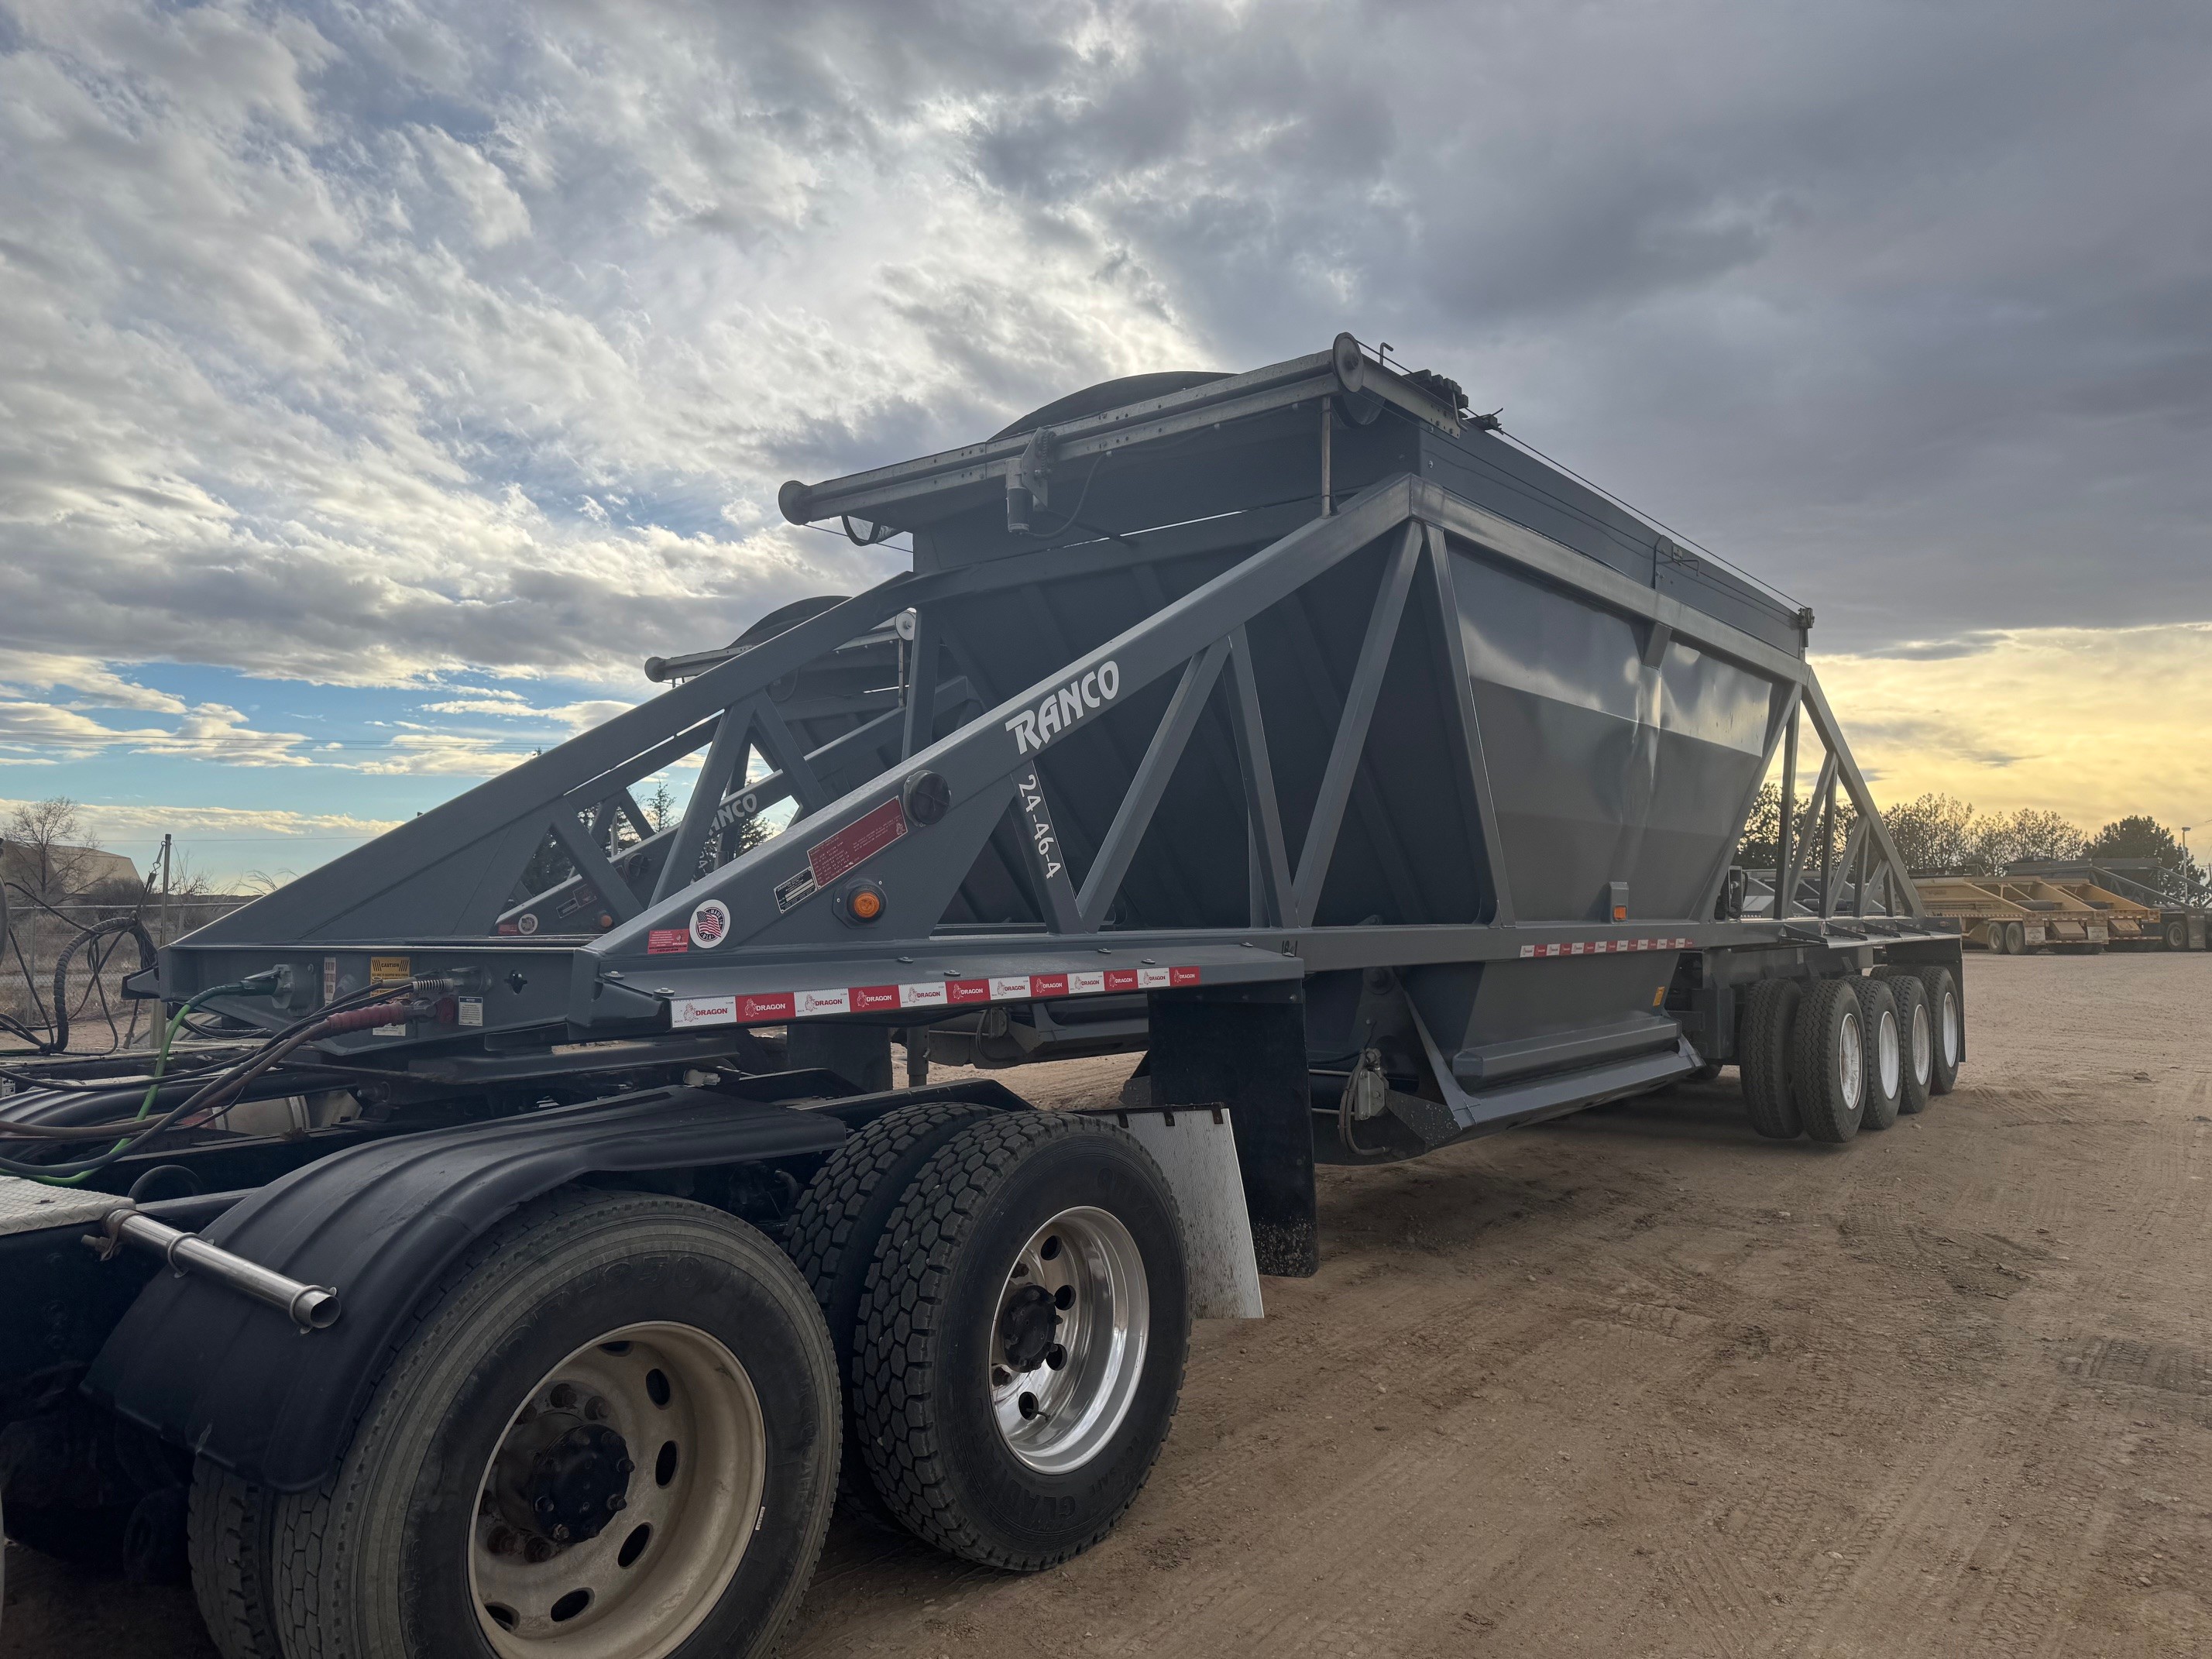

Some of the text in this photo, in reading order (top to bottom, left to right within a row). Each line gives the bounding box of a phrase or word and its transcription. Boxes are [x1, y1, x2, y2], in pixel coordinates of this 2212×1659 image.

[1005, 661, 1119, 755] RANCO
[1018, 774, 1062, 880] 24-46-4
[756, 1003, 786, 1012] DRAGON
[815, 998, 843, 1007] DRAGON
[917, 991, 941, 999] DRAGON
